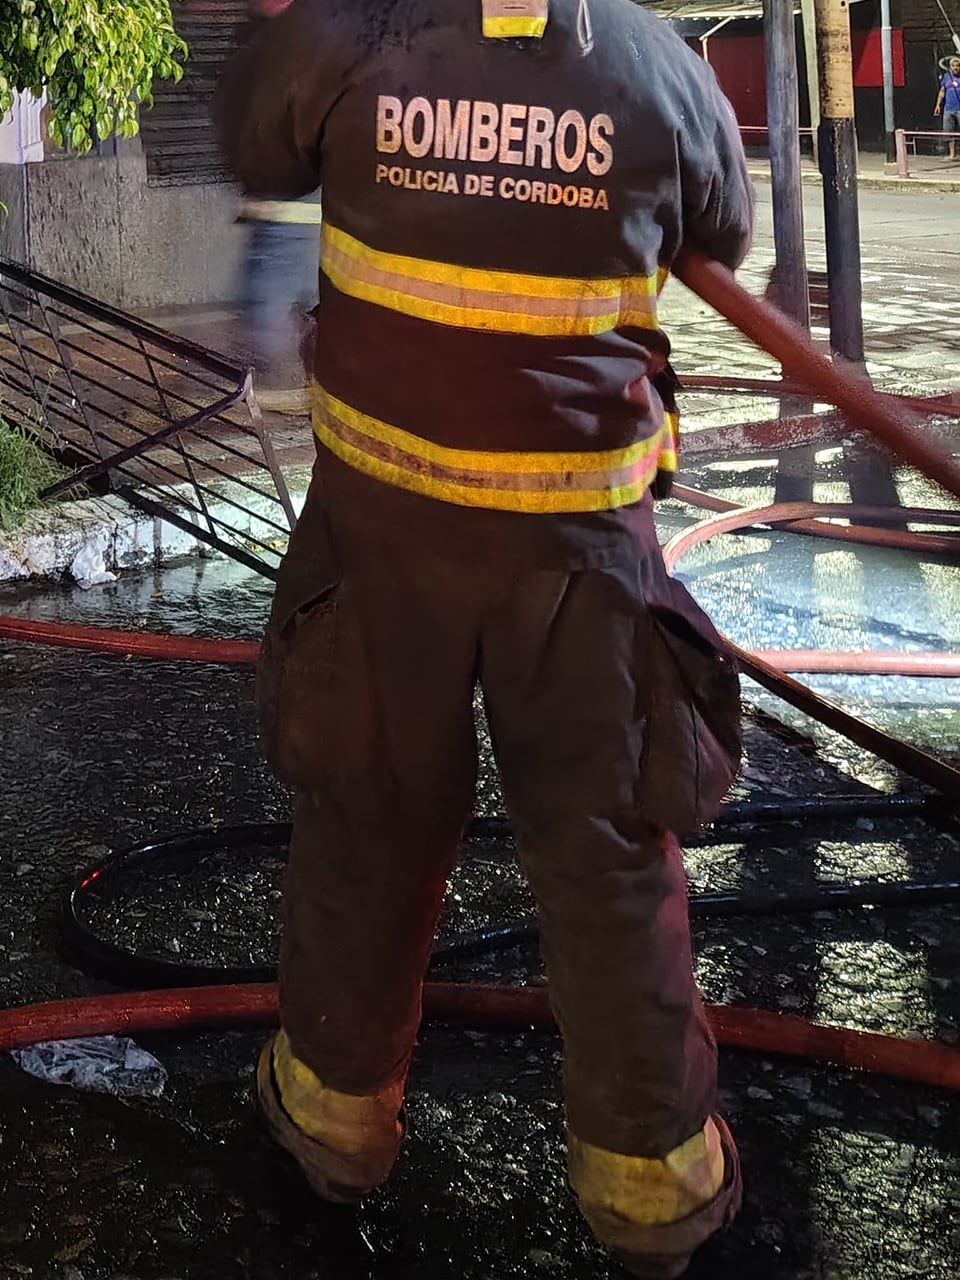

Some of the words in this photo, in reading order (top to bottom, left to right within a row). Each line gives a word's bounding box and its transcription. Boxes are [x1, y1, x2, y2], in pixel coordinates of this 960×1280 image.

[376, 95, 615, 177] BOMBEROS
[375, 163, 460, 195] POLICIA
[463, 173, 495, 197] DE
[498, 176, 610, 212] CORDOBA
